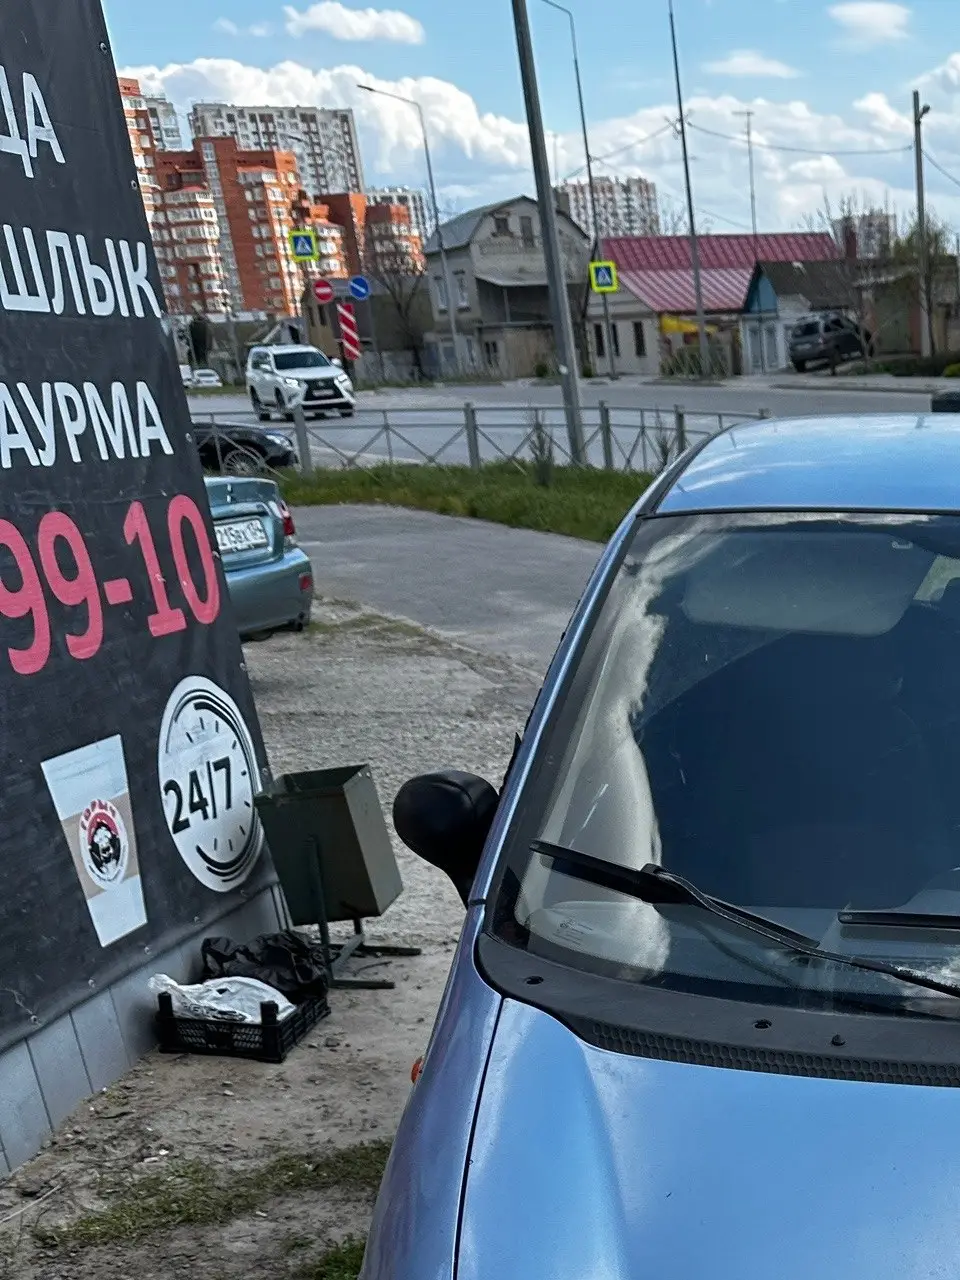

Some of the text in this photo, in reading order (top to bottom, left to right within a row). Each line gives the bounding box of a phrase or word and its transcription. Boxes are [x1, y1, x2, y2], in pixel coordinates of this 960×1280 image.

[0, 223, 162, 318] ШЛЫК
[0, 380, 174, 469] АУРМА
[0, 494, 220, 675] 99-10
[163, 755, 232, 835] 24/7
